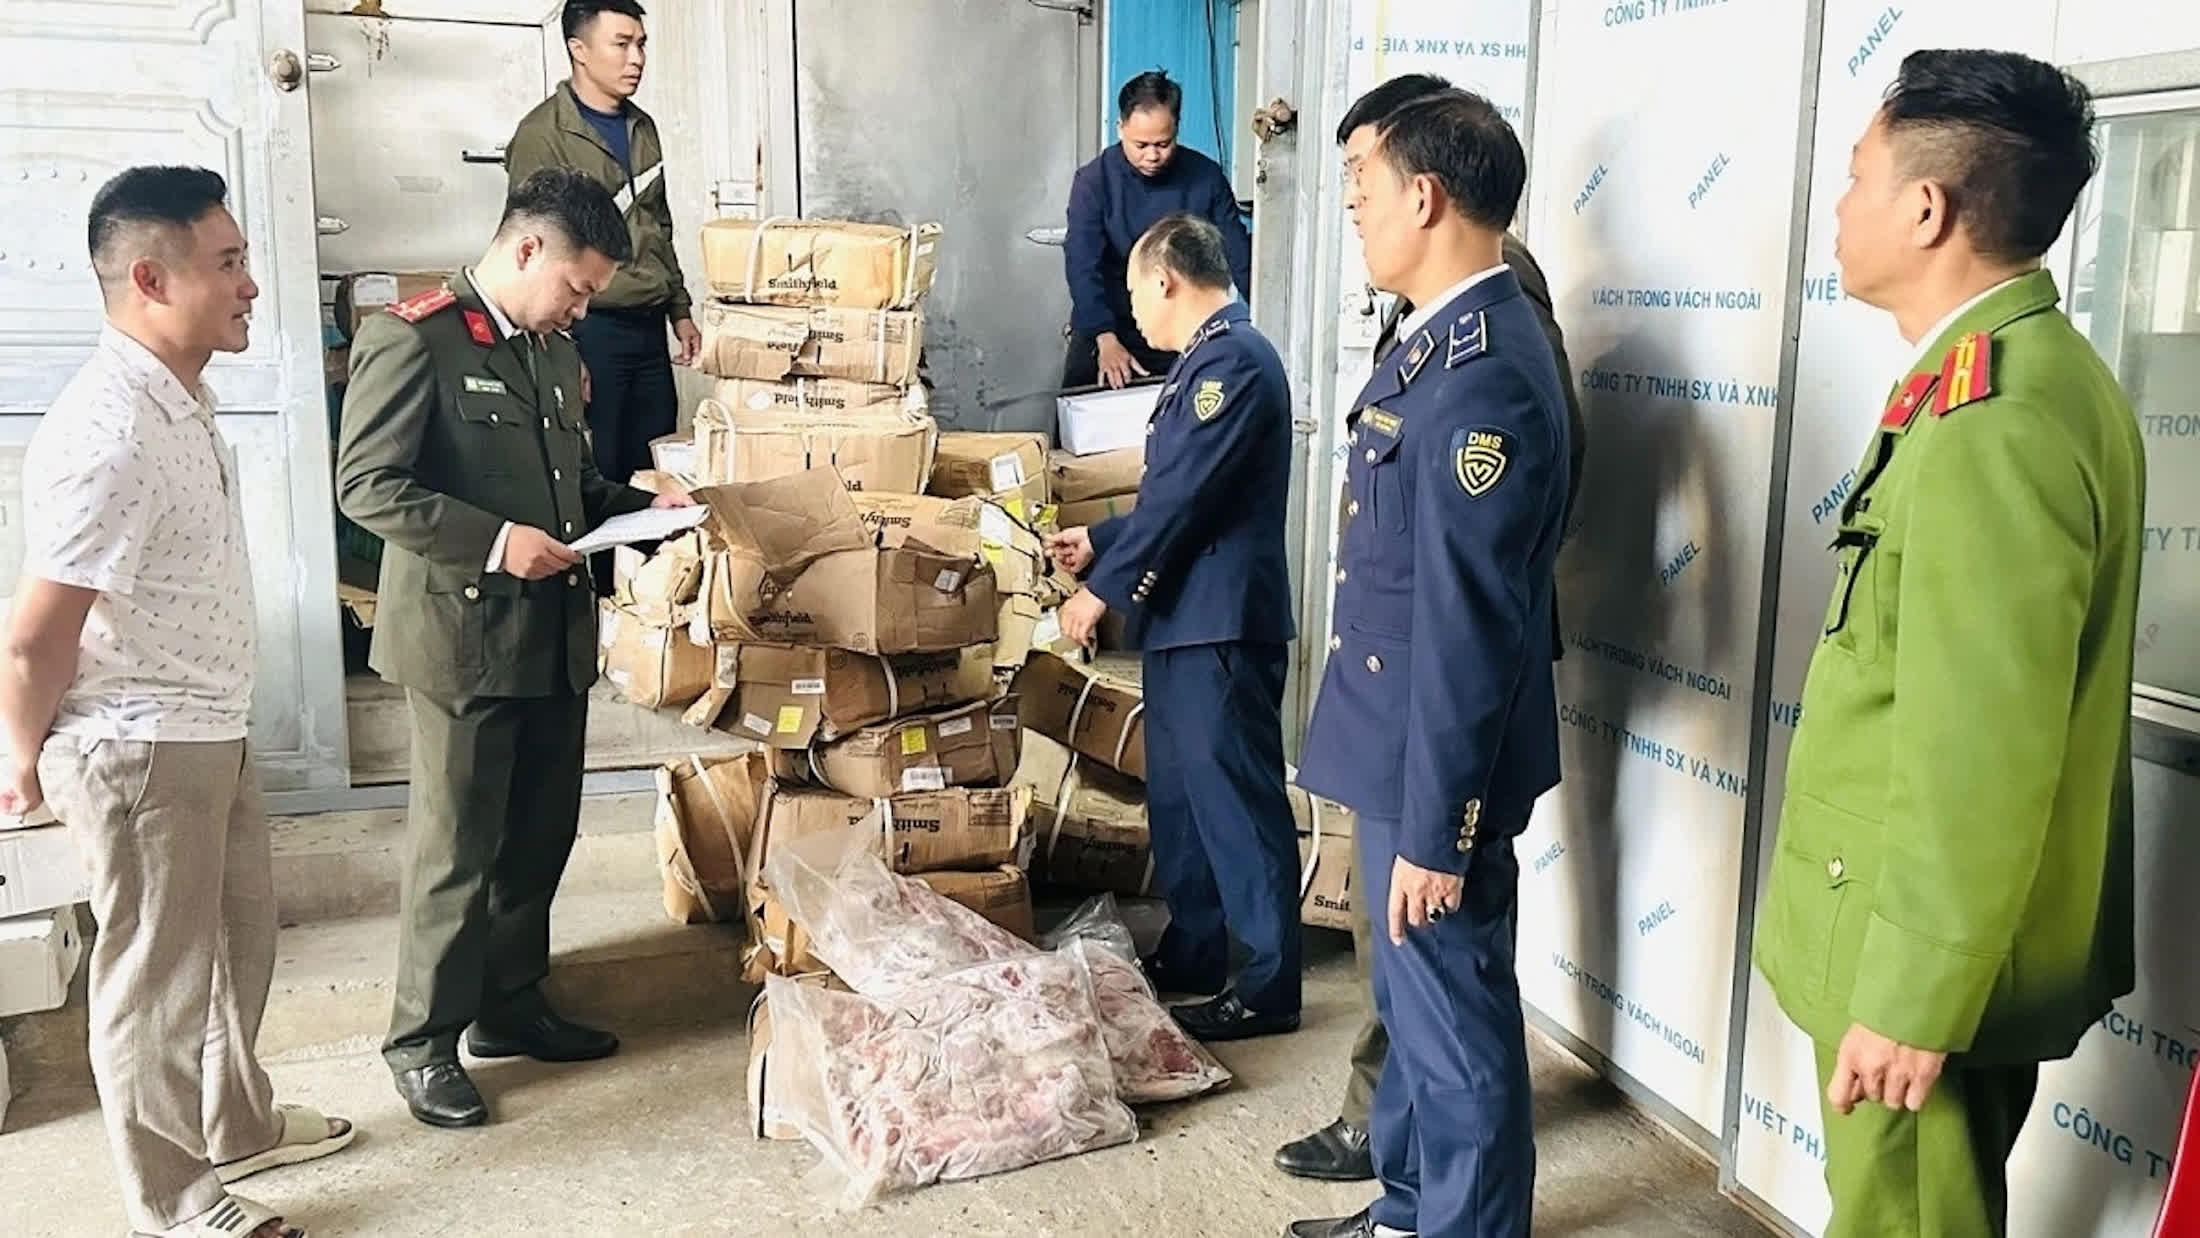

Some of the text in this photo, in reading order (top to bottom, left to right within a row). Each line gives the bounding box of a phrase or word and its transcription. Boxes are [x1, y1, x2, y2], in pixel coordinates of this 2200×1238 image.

[1416, 39, 1448, 55] XNK
[1480, 43, 1501, 57] SX
[1848, 7, 1903, 77] PANEL
[1574, 162, 1608, 215] PANEL
[1688, 152, 1730, 209] PANEL
[1627, 290, 1670, 308] TRONG
[1803, 271, 1848, 307] VIỆ
[1581, 368, 1619, 391] CÔNG
[1624, 374, 1644, 392] TY
[1647, 376, 1688, 398] TNHH
[1691, 380, 1712, 401] SX
[1718, 379, 1740, 402] VÀ
[1468, 431, 1503, 449] DMS
[1661, 540, 1701, 586] PANEL
[1602, 721, 1619, 743] TY
[1622, 731, 1662, 762] TNHH
[1666, 748, 1685, 772] SX
[1691, 758, 1711, 783] VÀ
[1533, 841, 1565, 874] PANEL
[1638, 900, 1676, 936] PANEL
[1584, 973, 1623, 1010] TRONG
[1745, 1092, 1825, 1160] VIỆT PH
[2053, 1101, 2133, 1165] CÔNG
